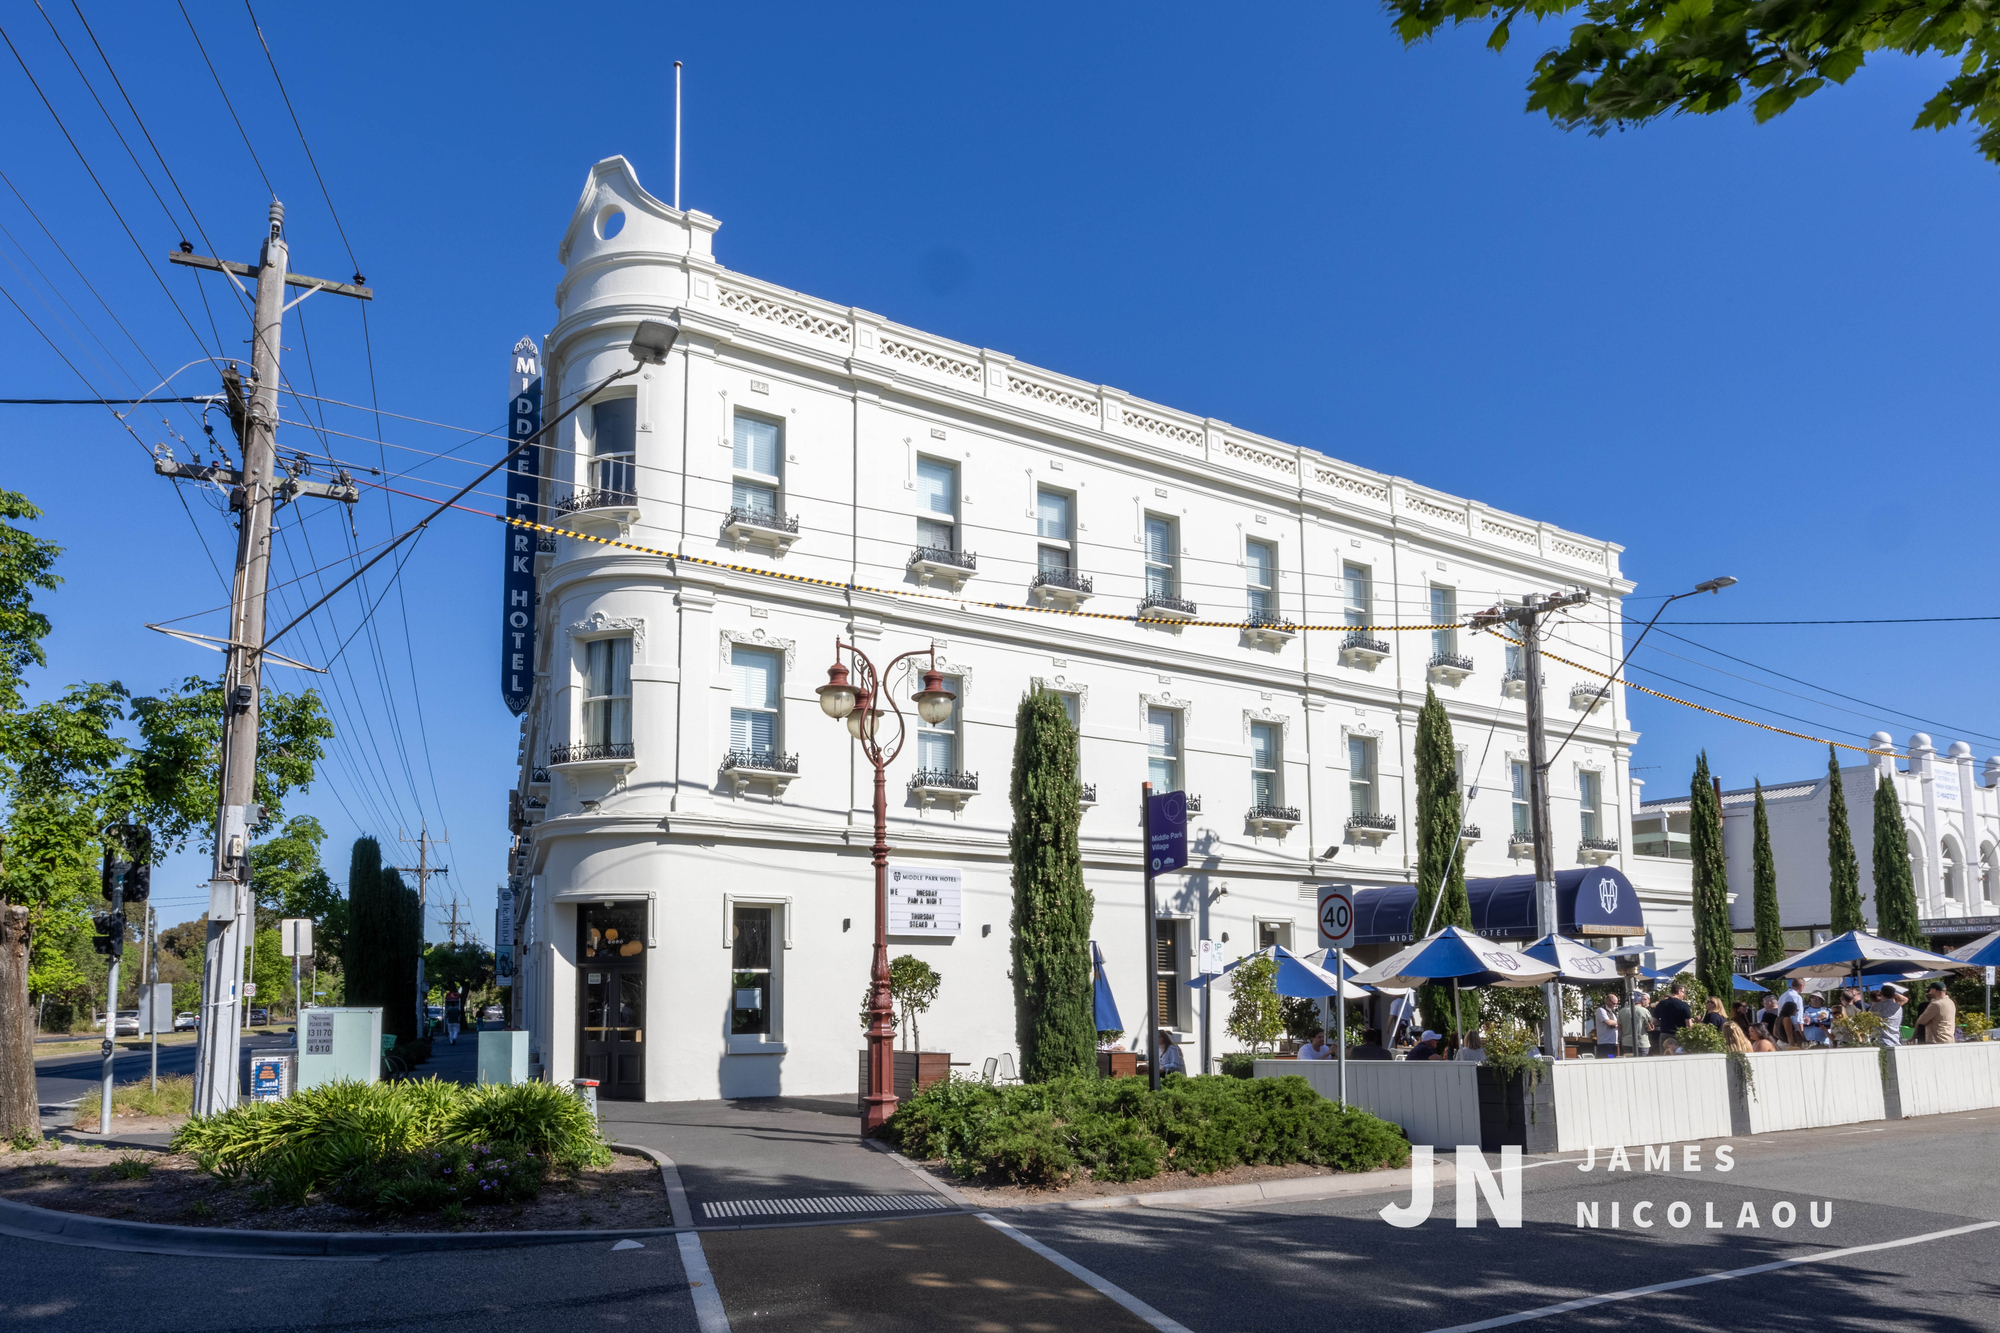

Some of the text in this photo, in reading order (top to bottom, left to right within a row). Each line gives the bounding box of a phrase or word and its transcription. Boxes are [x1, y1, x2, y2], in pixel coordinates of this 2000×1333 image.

[509, 356, 536, 692] MIDDLE PARK HOTEL
[1152, 831, 1183, 842] Middle Park
[1152, 843, 1169, 851] Village
[1323, 906, 1348, 927] 40
